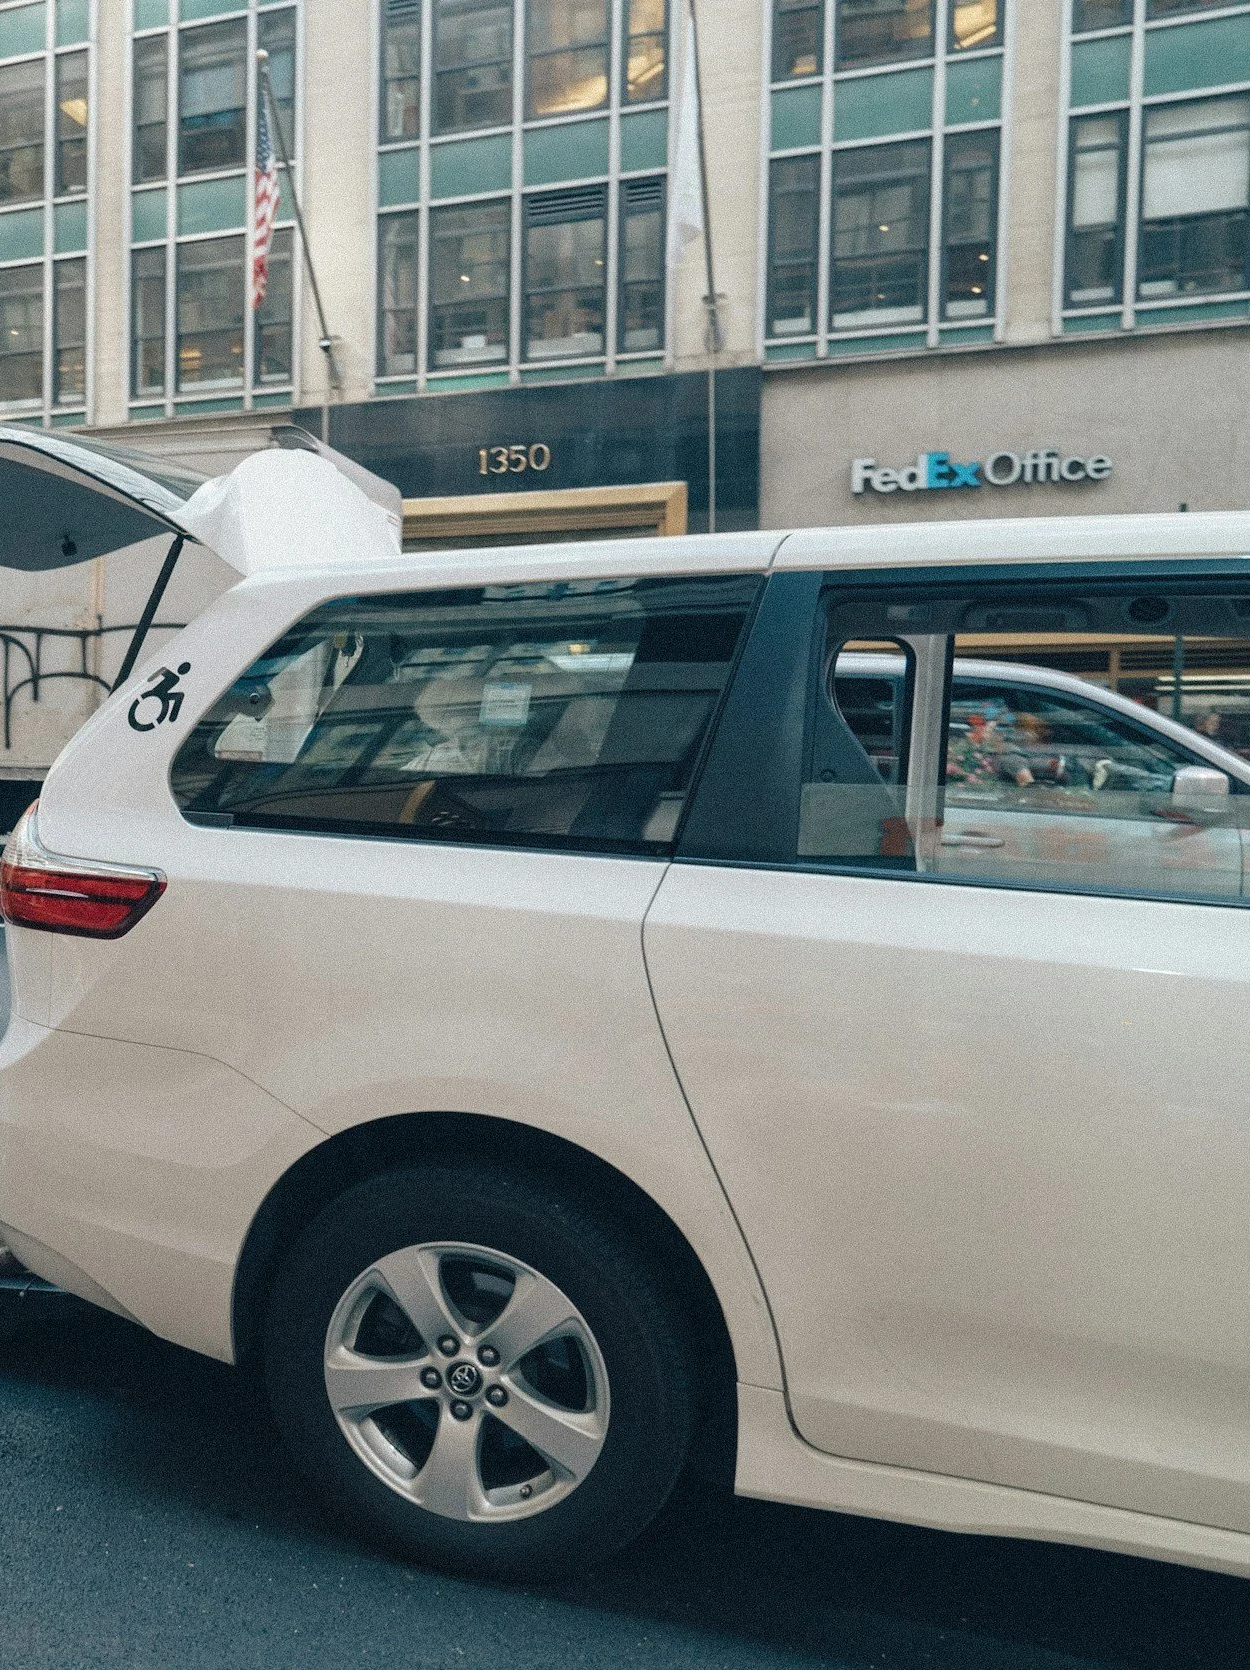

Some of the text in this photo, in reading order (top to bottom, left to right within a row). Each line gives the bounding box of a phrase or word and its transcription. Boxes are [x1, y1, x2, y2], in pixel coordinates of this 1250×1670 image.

[478, 443, 551, 475] 1350
[851, 449, 1112, 494] FedEx Office
